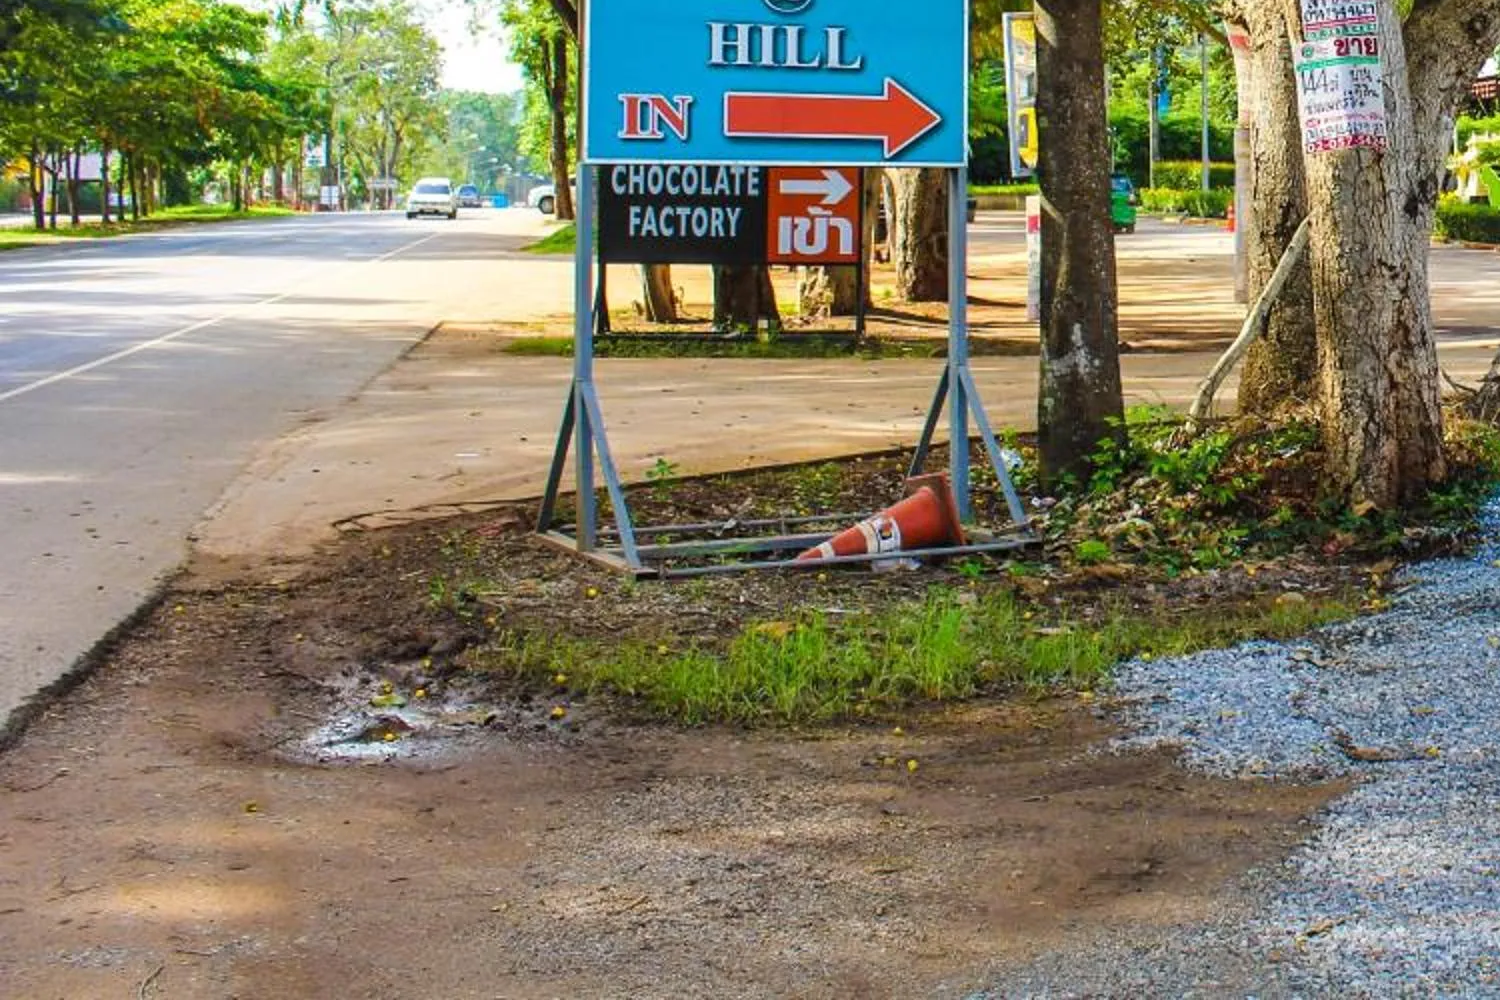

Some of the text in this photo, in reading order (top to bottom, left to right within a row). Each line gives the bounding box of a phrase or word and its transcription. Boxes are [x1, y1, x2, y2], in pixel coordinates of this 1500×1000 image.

[706, 21, 863, 69] HILL
[1334, 37, 1378, 56] ขาย
[617, 93, 693, 140] IN
[611, 165, 760, 196] CHOCOLATE
[629, 207, 742, 237] FACTORY
[777, 206, 854, 255] เข้า
